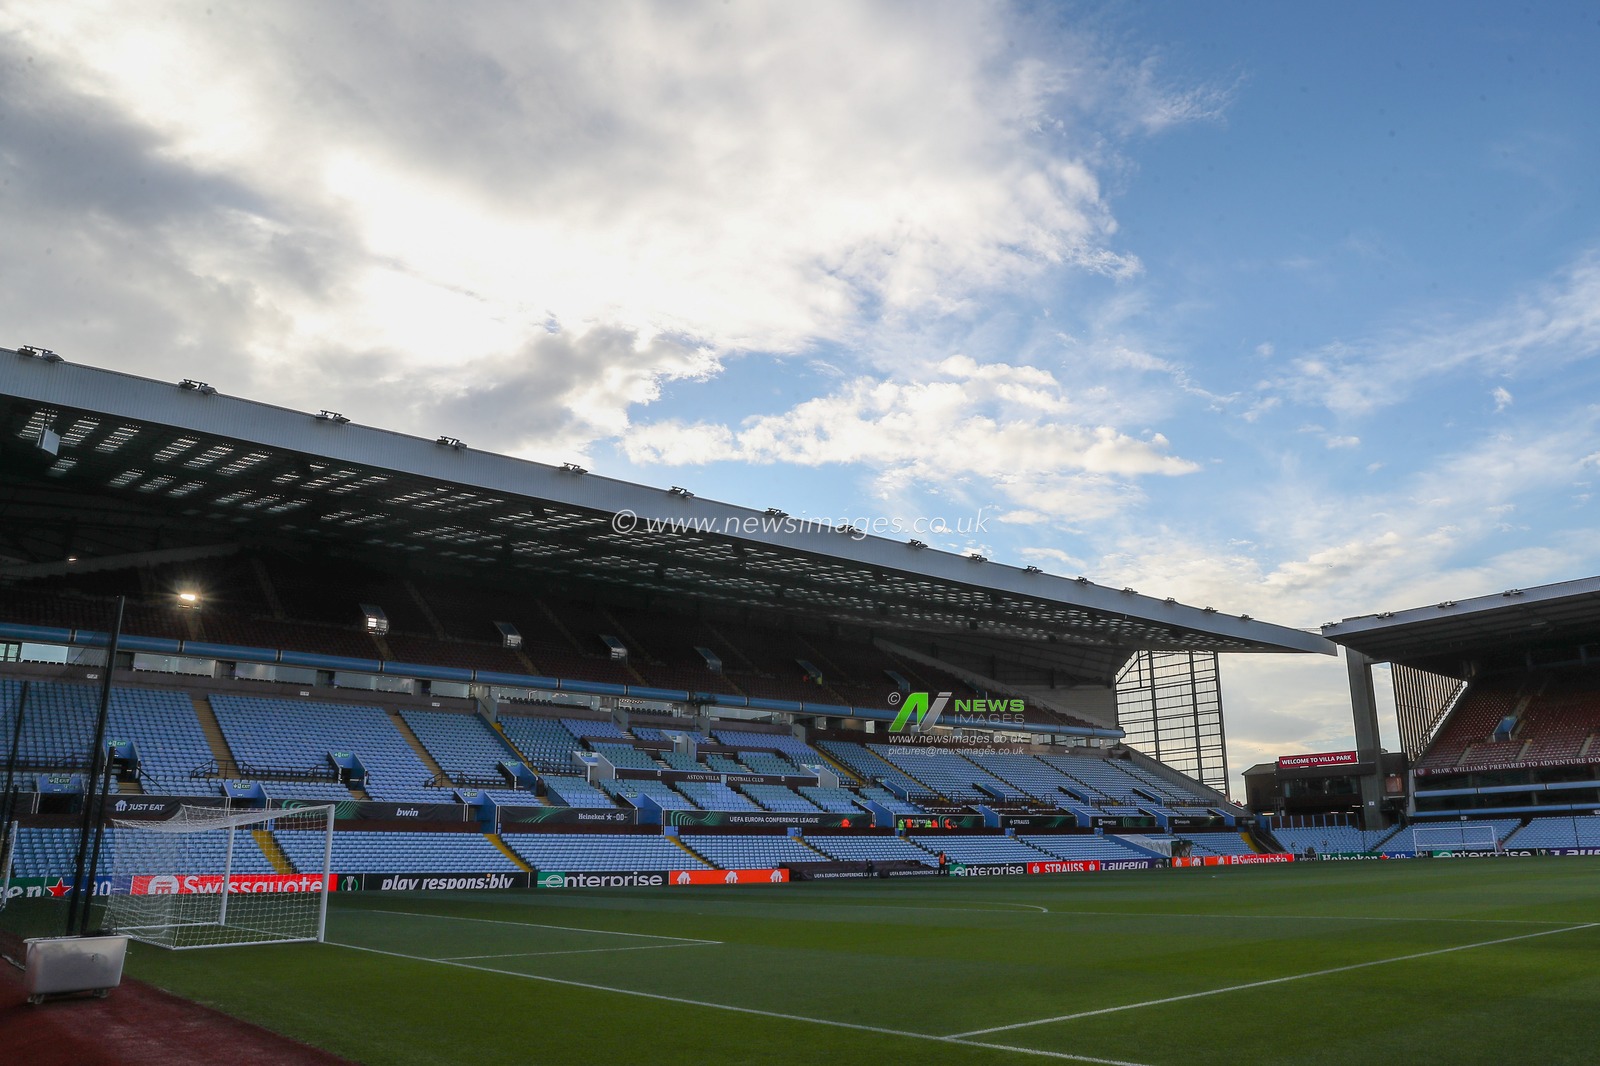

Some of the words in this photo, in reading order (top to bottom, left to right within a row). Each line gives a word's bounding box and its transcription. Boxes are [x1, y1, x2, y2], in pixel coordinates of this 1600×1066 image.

[1453, 764, 1488, 773] WILLIAMS
[1489, 761, 1526, 770] PREPARED
[1539, 757, 1587, 767] ADVENTURE
[128, 803, 148, 811] JUST
[396, 807, 419, 817] bwin
[953, 863, 1024, 877] enterprise
[1045, 863, 1084, 873] STRAUSS
[184, 875, 324, 893] Swissquote
[544, 871, 663, 887] enterprise
